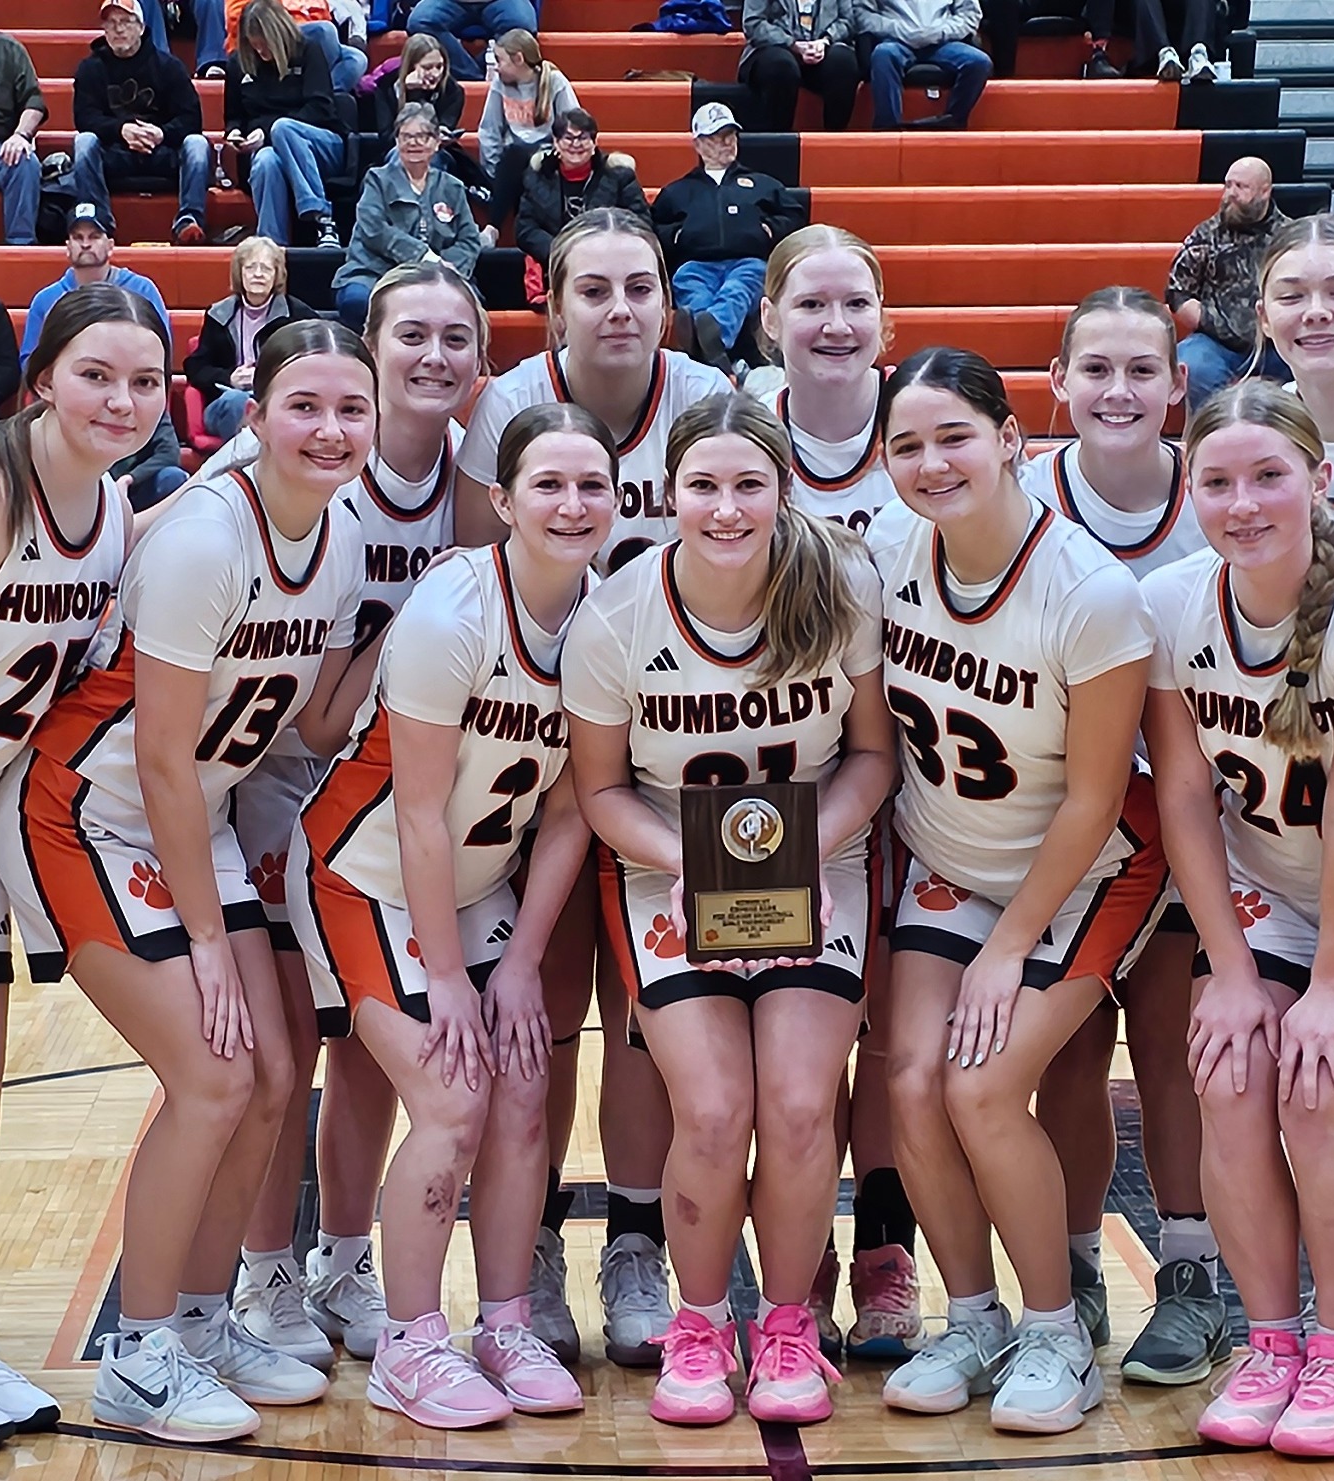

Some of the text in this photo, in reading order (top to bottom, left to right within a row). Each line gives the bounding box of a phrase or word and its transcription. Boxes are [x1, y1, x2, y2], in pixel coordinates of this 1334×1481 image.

[218, 618, 335, 660] UMBOLD
[883, 617, 1038, 709] HUMBOLDT
[194, 673, 299, 769] 13
[638, 676, 834, 735] HUMBOLDT
[887, 684, 1019, 801] 33
[462, 757, 540, 847] 2
[1213, 749, 1328, 840] 24
